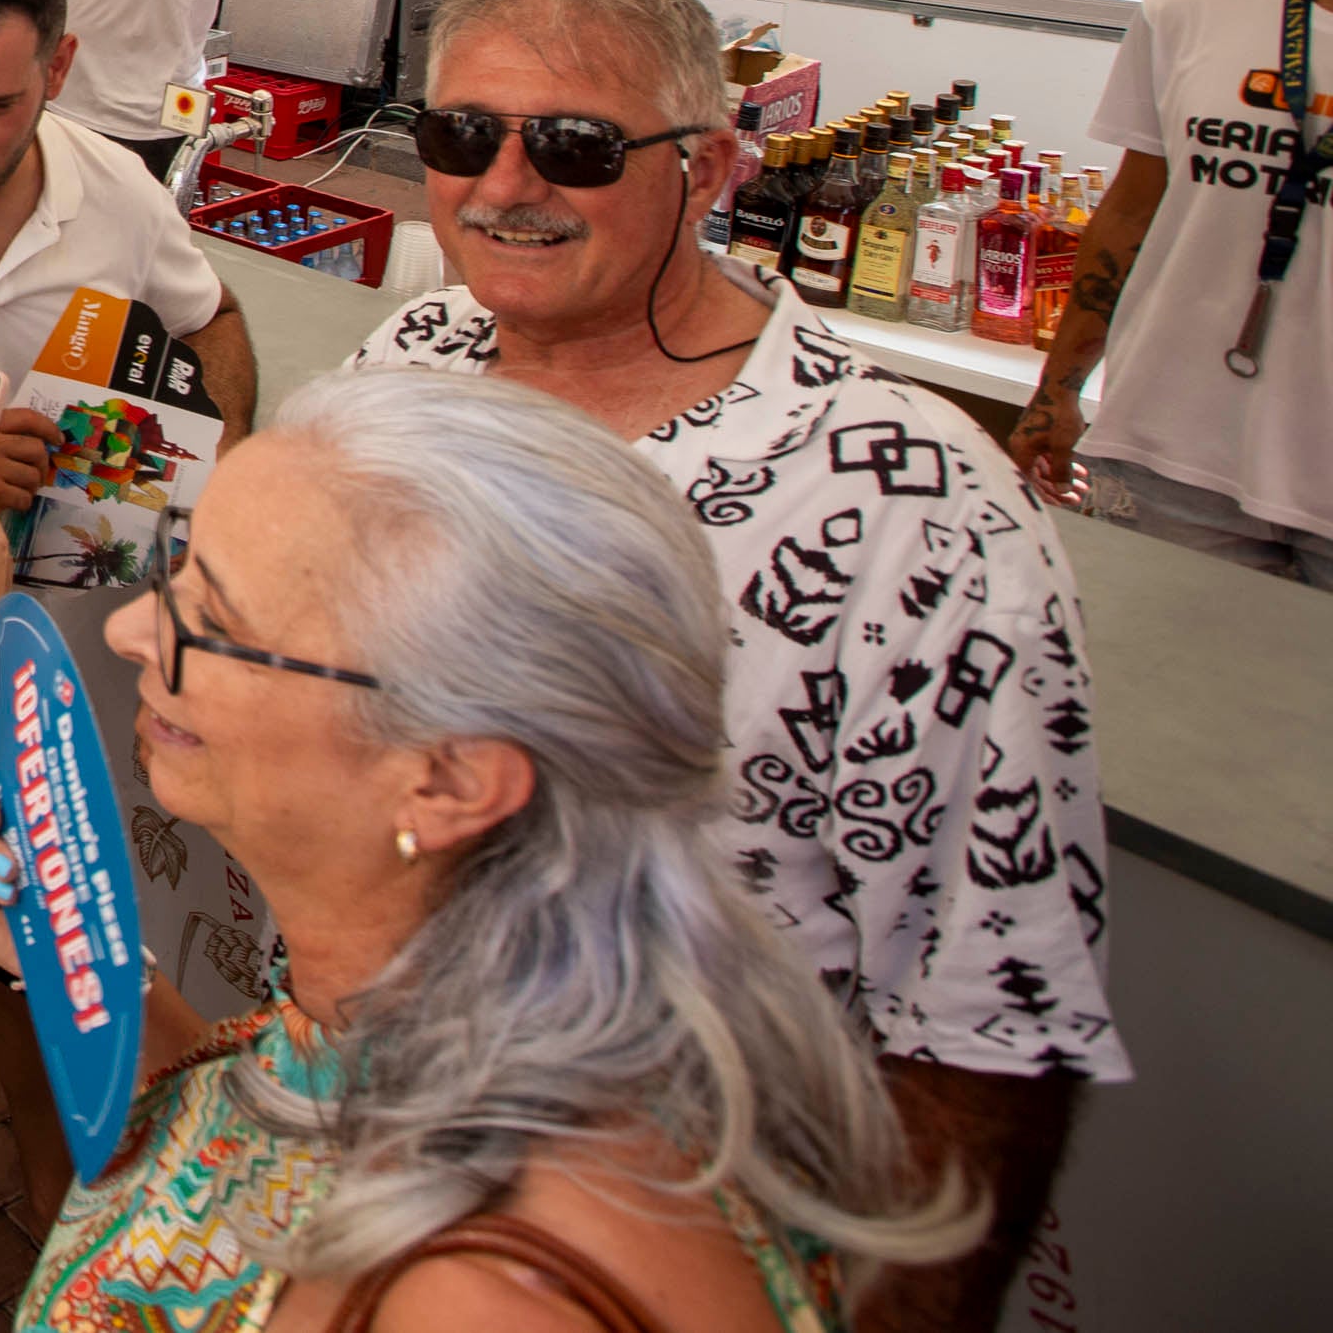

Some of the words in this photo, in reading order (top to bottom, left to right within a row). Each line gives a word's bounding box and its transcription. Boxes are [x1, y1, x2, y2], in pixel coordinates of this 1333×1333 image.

[70, 298, 102, 358] Mango
[13, 658, 112, 1035] ¡OFERTONES!
[57, 712, 101, 864] Domino's
[90, 868, 130, 967] Pizza
[225, 862, 254, 922] ZA
